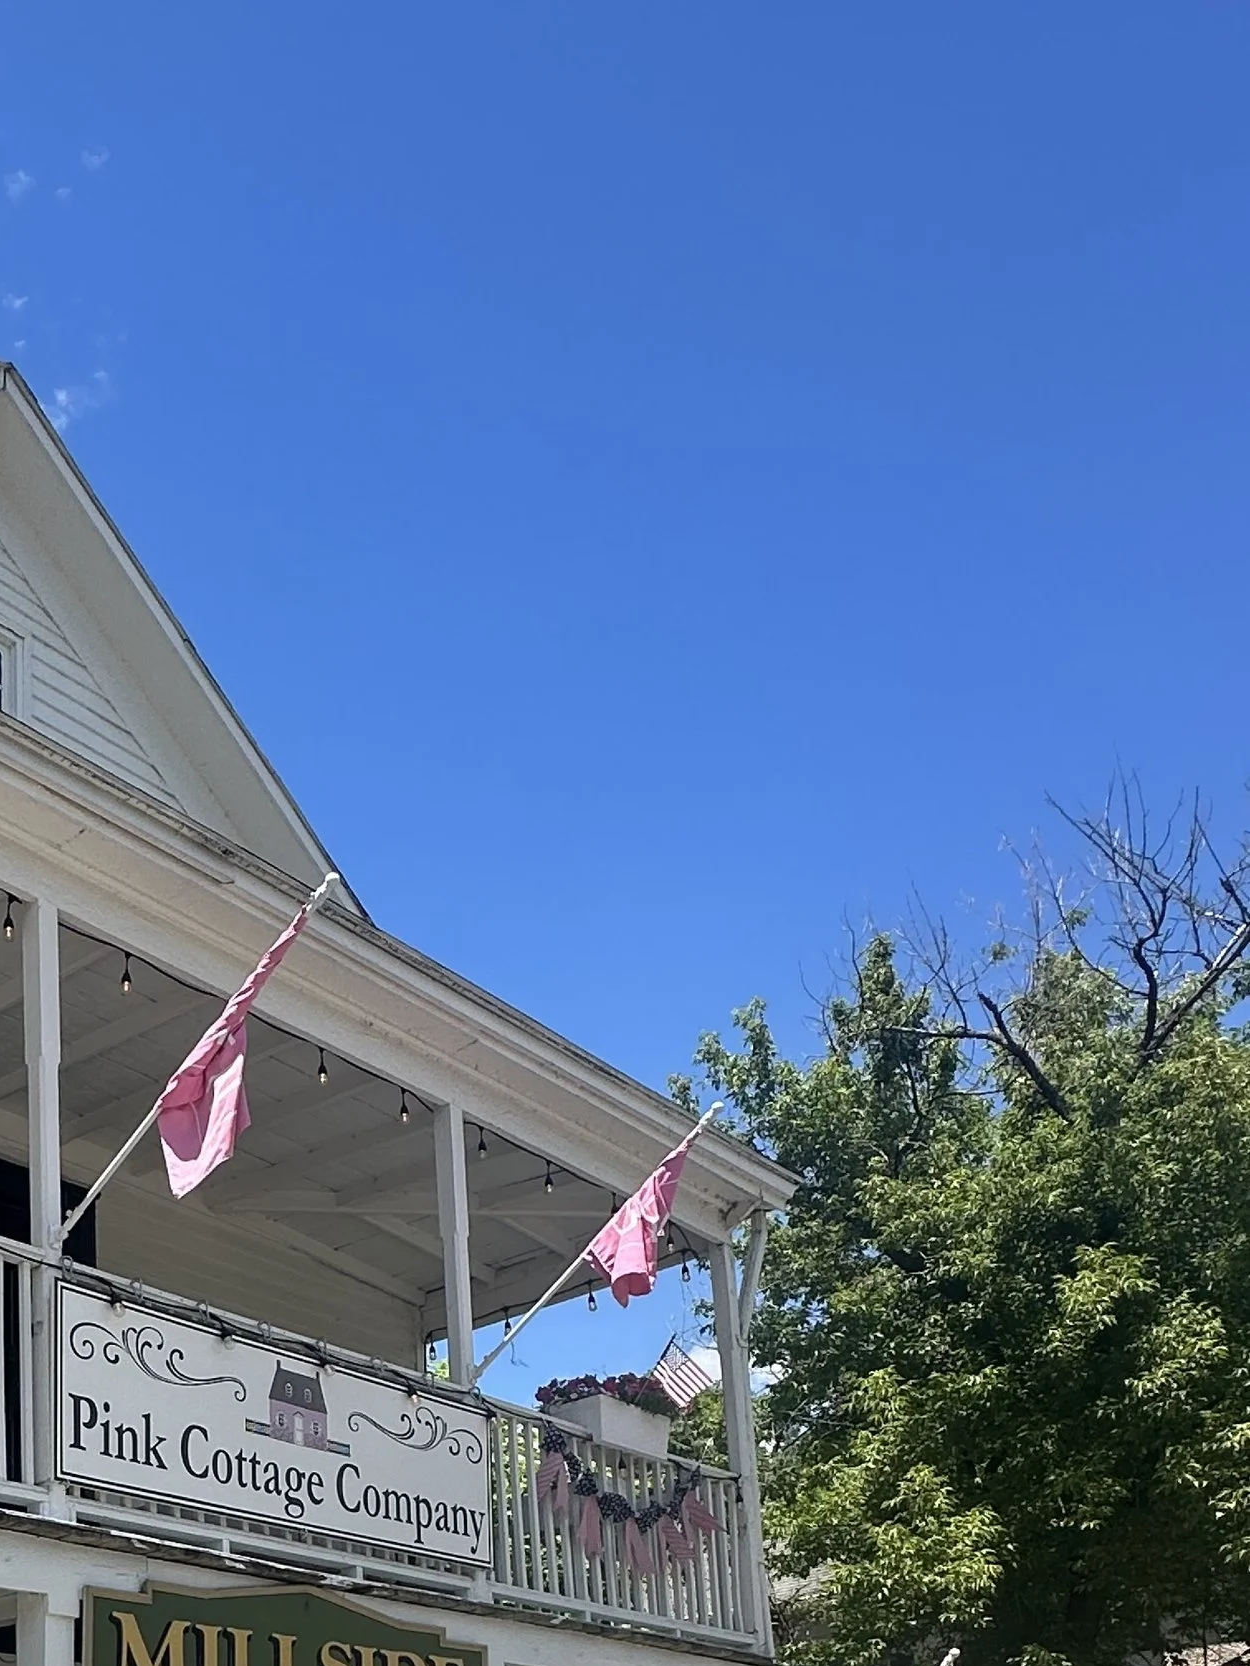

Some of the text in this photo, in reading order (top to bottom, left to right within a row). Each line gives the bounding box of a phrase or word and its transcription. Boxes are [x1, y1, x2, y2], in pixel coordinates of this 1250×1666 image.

[67, 1392, 486, 1554] Pink Cottage Company
